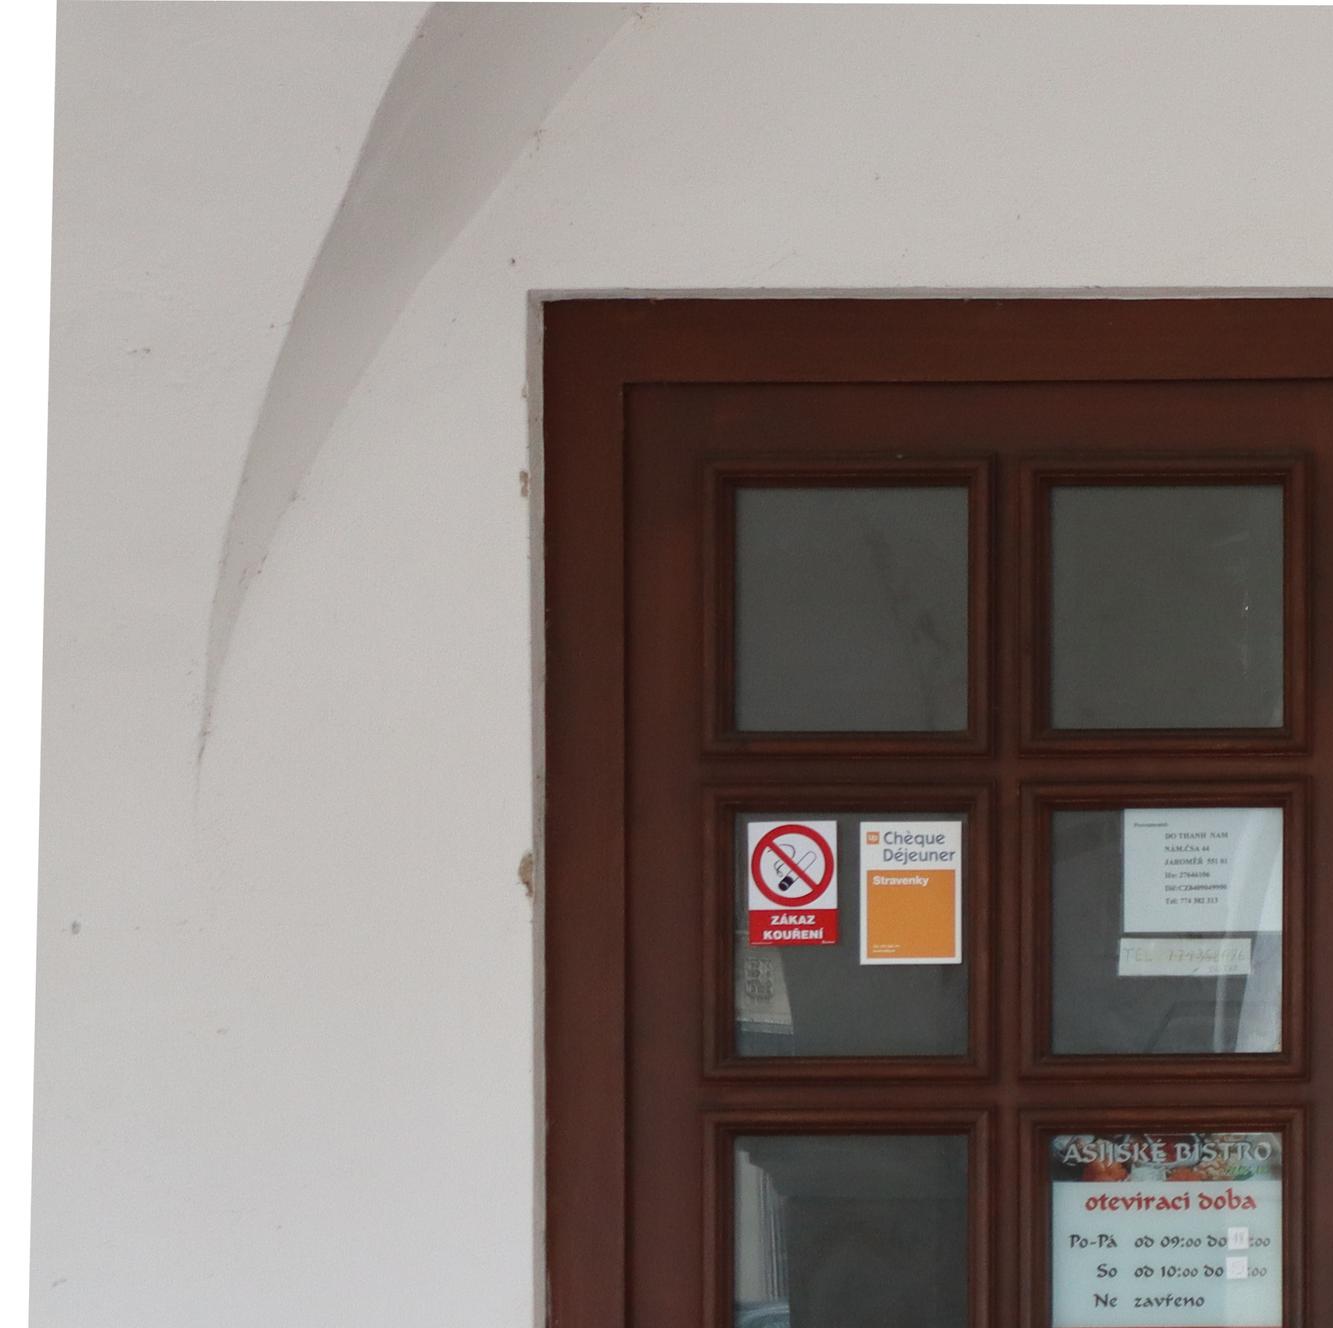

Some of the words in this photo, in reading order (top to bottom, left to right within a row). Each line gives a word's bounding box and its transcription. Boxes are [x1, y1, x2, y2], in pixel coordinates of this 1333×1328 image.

[883, 831, 946, 850] Chèque
[883, 848, 956, 865] Déjeuner
[873, 875, 930, 887] Stravenky
[771, 913, 816, 925] ZÁKAZ
[763, 927, 824, 940] KOUŘENÍ
[1063, 1139, 1166, 1168] ASIJSKÉ
[1174, 1142, 1272, 1163] BISTRO
[1198, 1187, 1257, 1211] doba
[1069, 1233, 1119, 1249] Po-Pá
[1134, 1235, 1154, 1248] od
[1160, 1236, 1202, 1249] 09:00
[1207, 1235, 1228, 1248] do
[1096, 1264, 1118, 1279] So
[1134, 1265, 1154, 1278] od
[1160, 1266, 1199, 1278] 10:00
[1203, 1265, 1224, 1278] do
[1093, 1293, 1118, 1309] Ne
[1134, 1293, 1206, 1309] zavřeno
